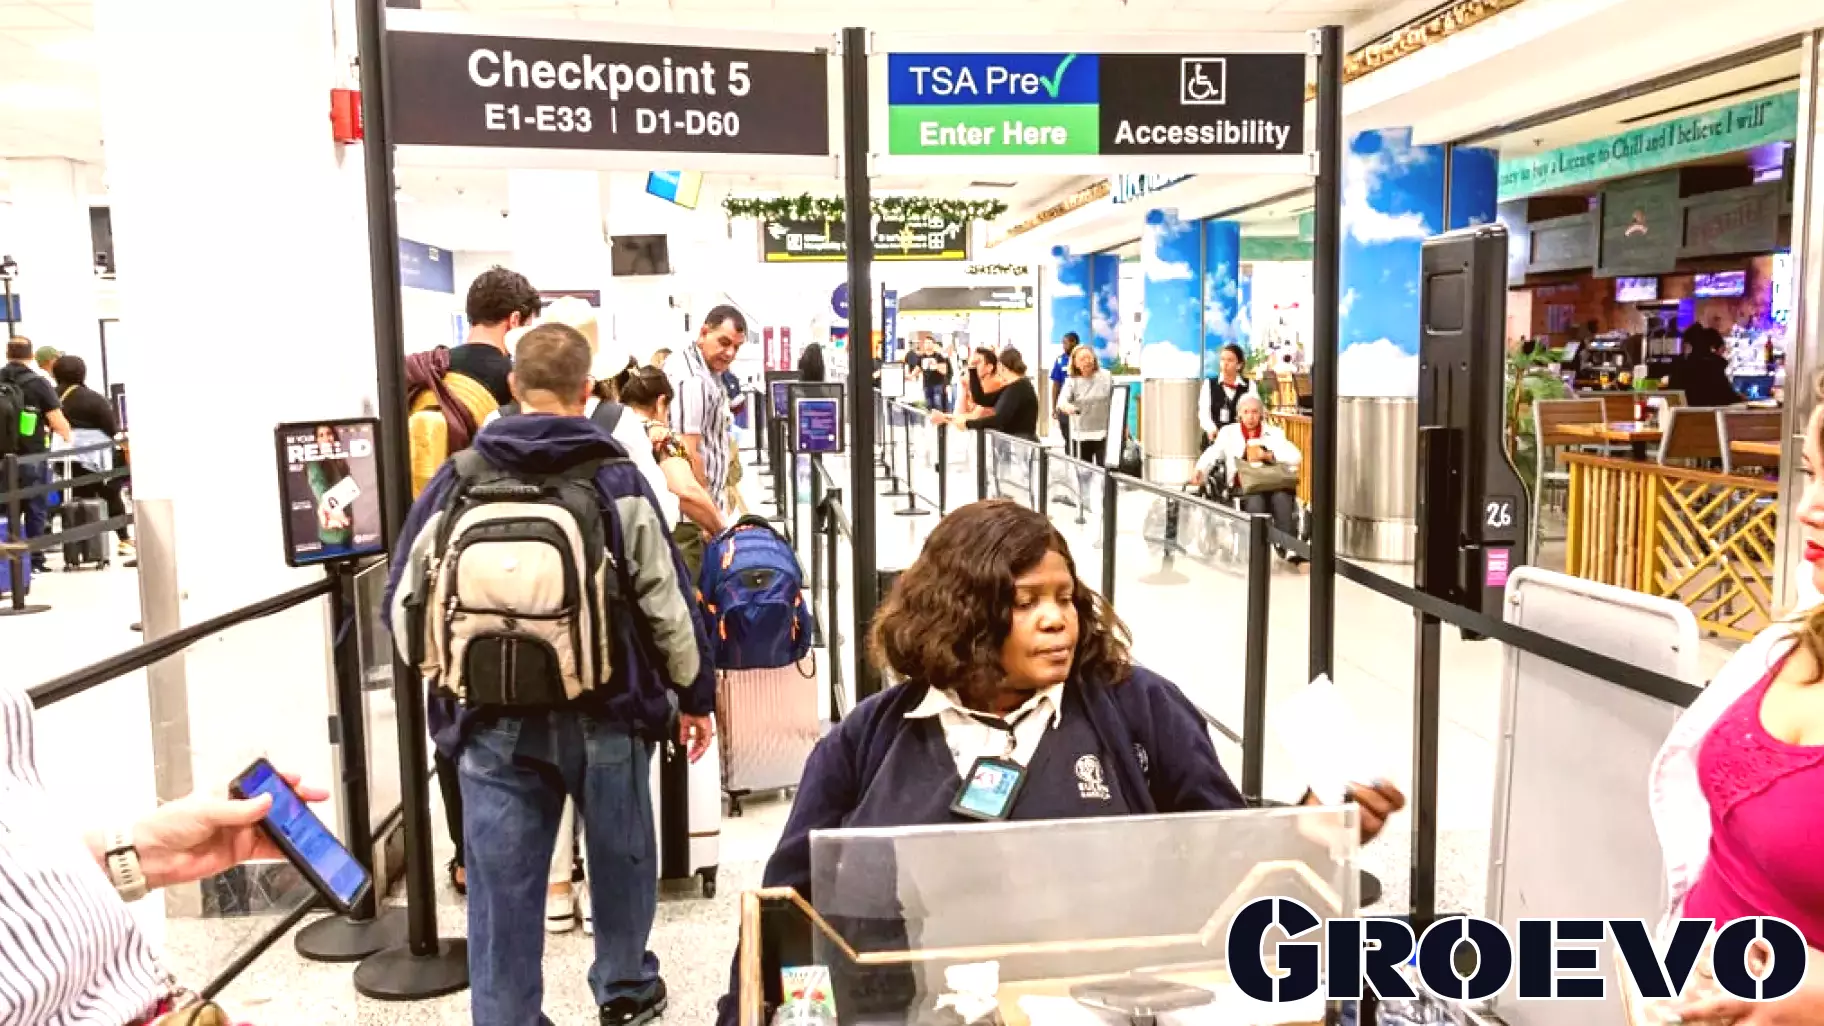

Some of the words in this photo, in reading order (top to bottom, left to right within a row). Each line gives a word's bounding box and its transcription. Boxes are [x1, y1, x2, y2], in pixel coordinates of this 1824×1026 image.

[468, 48, 717, 100] Checkpoint
[728, 61, 751, 97] 5
[909, 66, 978, 95] TSA
[986, 66, 1040, 95] Pre
[485, 103, 592, 133] E1-E33
[636, 107, 740, 137] D1-D60
[920, 120, 996, 146] Enter
[1003, 120, 1068, 145] Here
[1114, 119, 1291, 150] Accessibility
[1559, 151, 1596, 173] License
[1612, 133, 1644, 160] Chill
[1645, 127, 1666, 151] and
[1669, 122, 1675, 147] I
[1677, 118, 1723, 145] believe
[1727, 109, 1733, 134] I
[1487, 501, 1511, 528] 26
